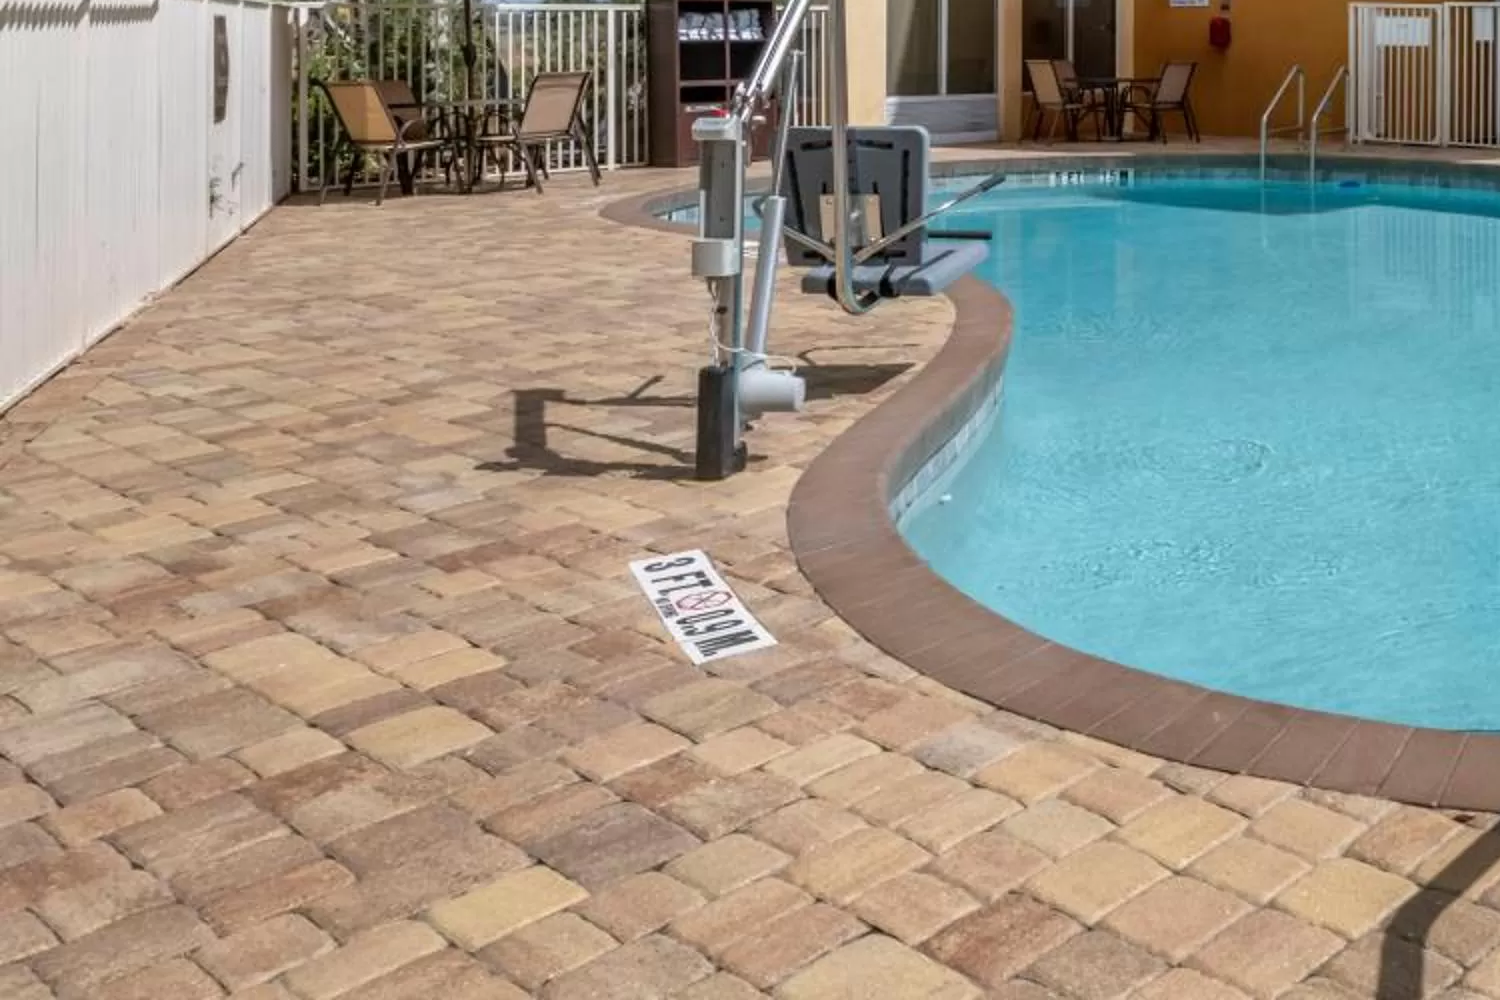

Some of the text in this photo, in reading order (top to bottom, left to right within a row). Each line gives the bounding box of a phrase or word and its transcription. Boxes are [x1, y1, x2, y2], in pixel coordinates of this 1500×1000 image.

[643, 556, 696, 573] 3
[651, 570, 714, 596] FT
[676, 608, 745, 637] 0.9
